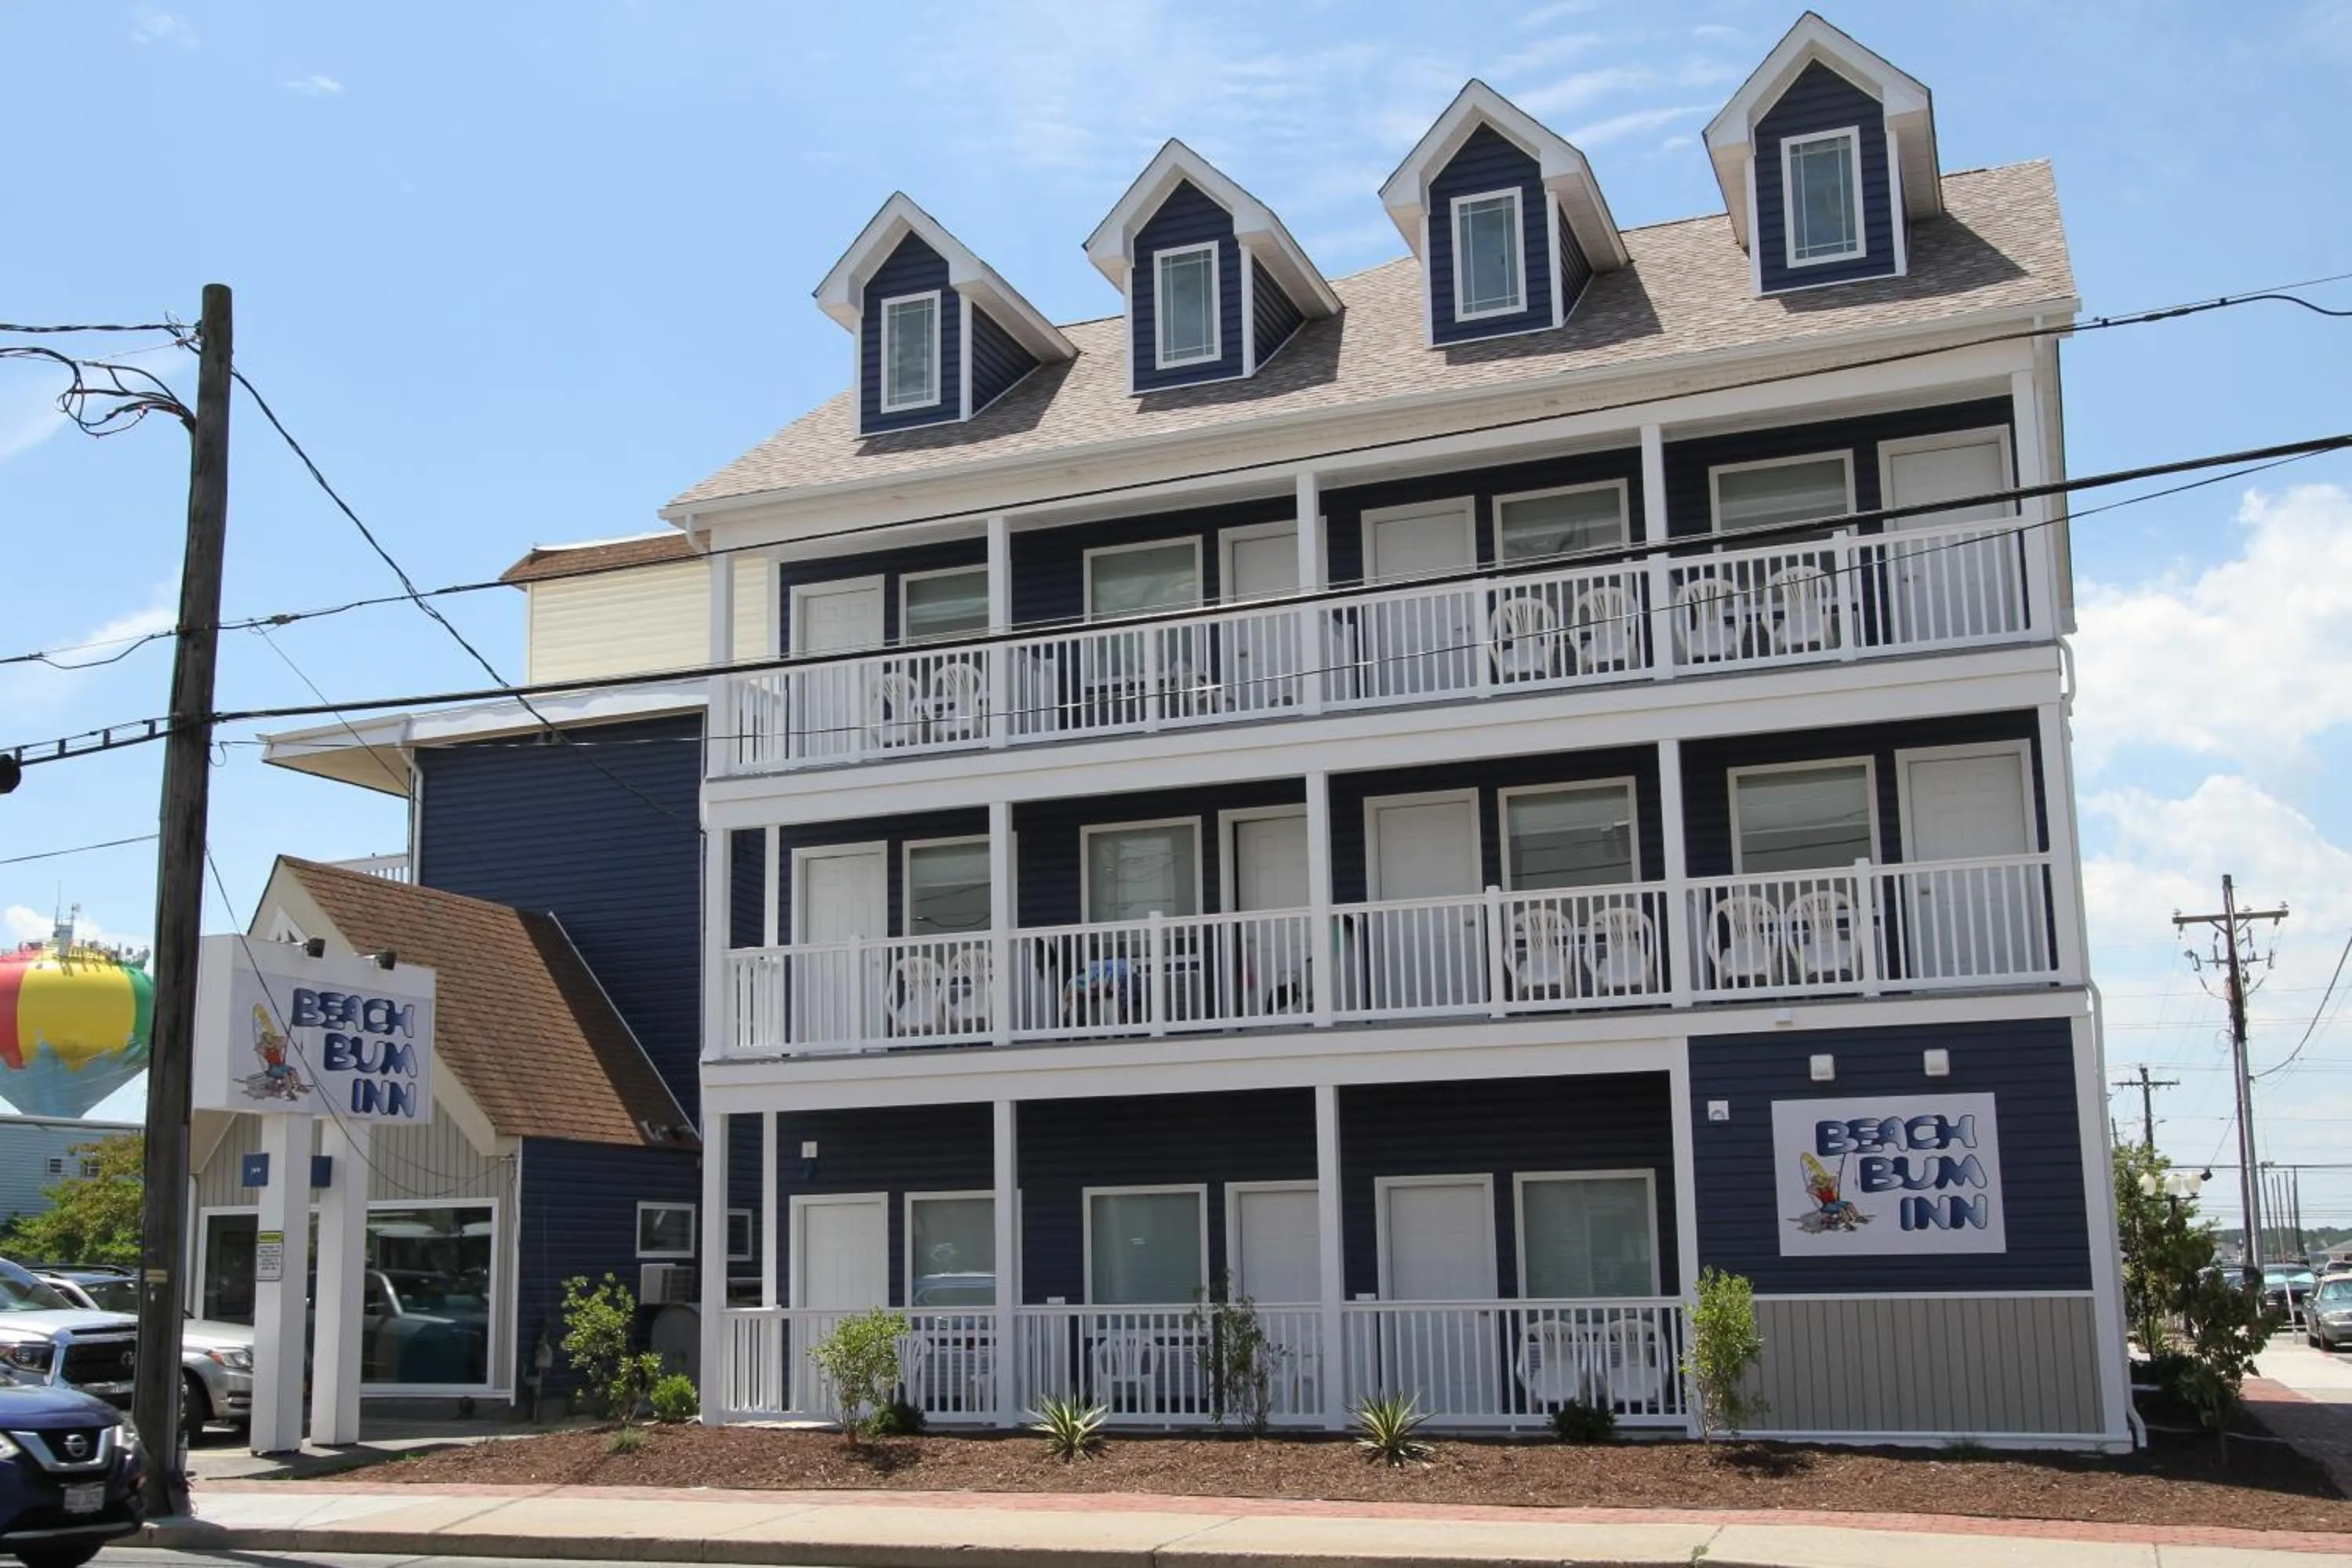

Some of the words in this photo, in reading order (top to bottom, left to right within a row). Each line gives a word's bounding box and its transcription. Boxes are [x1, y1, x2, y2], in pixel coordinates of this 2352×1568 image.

[292, 988, 415, 1038] BEACH
[324, 1033, 418, 1079] BUM
[351, 1078, 417, 1118] INN
[1816, 1115, 1977, 1156] BEACH
[1860, 1154, 1987, 1192] BUM
[1900, 1194, 1987, 1231] INN
